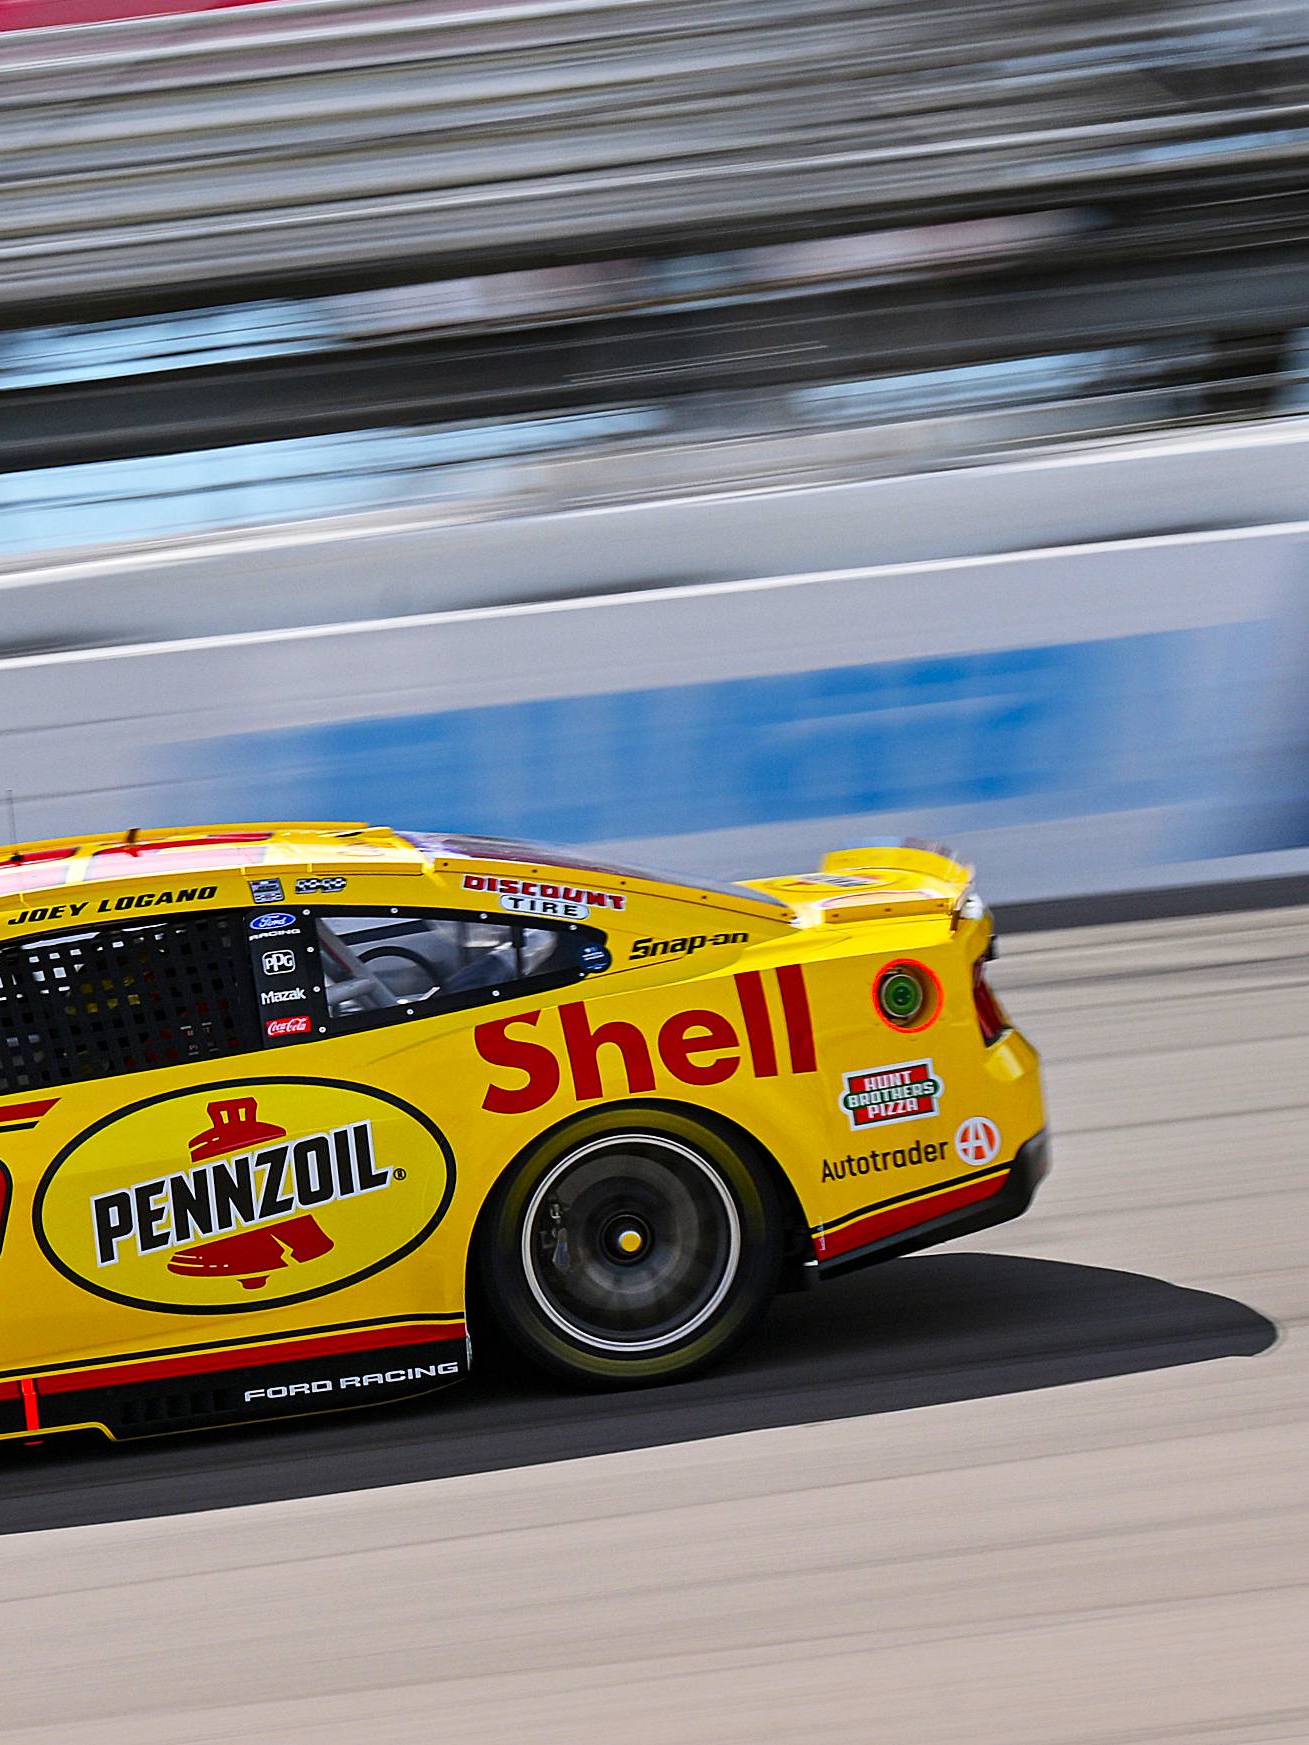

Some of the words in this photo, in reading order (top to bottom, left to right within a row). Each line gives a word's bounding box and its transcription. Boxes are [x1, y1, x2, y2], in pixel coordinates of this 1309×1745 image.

[7, 902, 89, 925] JOEY
[97, 886, 218, 912] LOGANO
[462, 874, 626, 911] DISCOUNT
[508, 896, 579, 917] TIRE
[256, 914, 288, 928] Ford
[249, 929, 301, 941] RACING
[628, 931, 749, 961] Snap-on
[265, 953, 293, 971] PPG
[260, 987, 307, 1005] Mazak
[474, 964, 817, 1114] Shell
[864, 1070, 913, 1091] HUNT
[847, 1081, 935, 1108] BROTHERS
[867, 1098, 919, 1118] PIZZA
[821, 1140, 949, 1183] Autotrader
[92, 1121, 391, 1266] PENNZOIL
[244, 1380, 333, 1402] FORD
[340, 1361, 459, 1389] RACING
